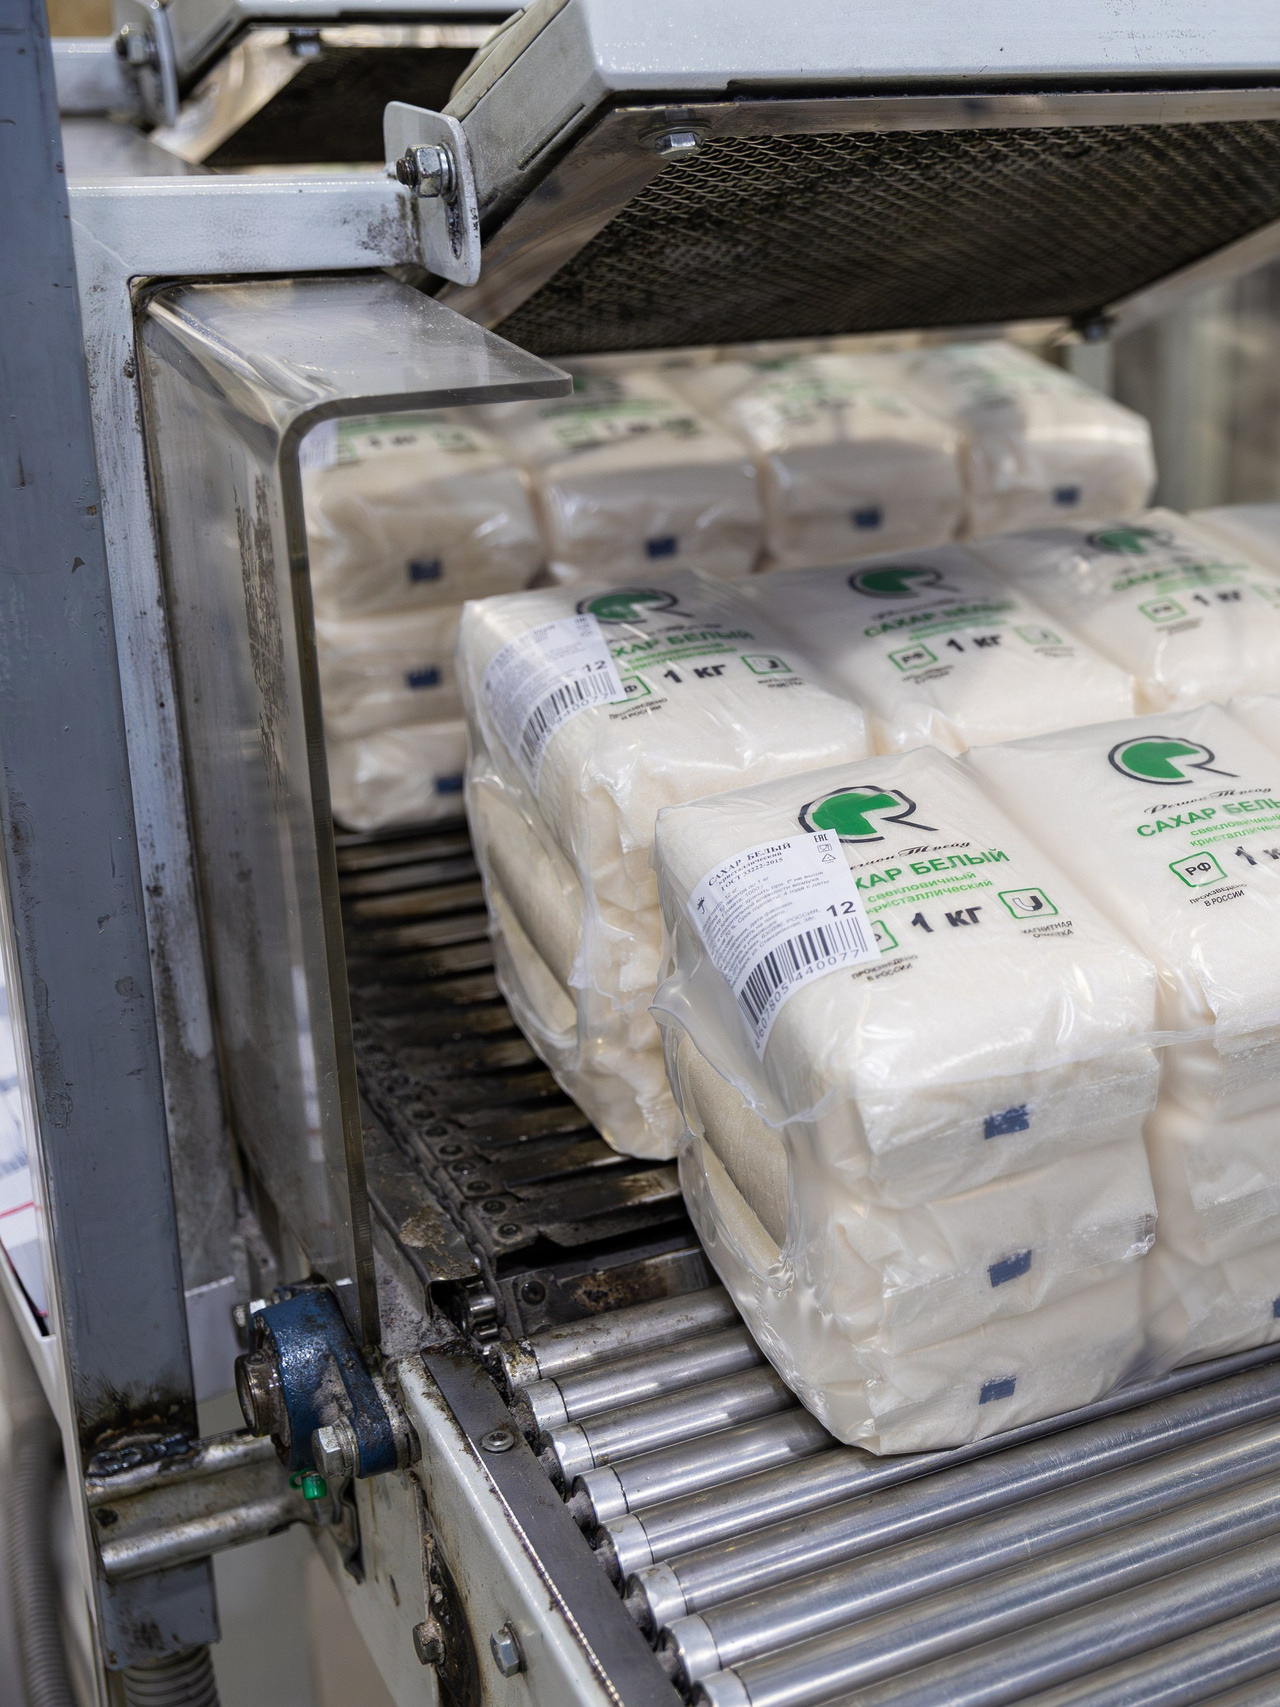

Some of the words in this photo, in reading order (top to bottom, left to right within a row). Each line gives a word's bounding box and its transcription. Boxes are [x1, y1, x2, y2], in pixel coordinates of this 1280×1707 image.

[612, 640, 660, 659] ХАР
[946, 638, 965, 652] 1
[584, 660, 607, 672] 12
[663, 669, 683, 684] 1
[1136, 807, 1217, 838] САХАР
[708, 859, 742, 887] САХАР
[746, 842, 791, 861] БЕЛЫЙ
[849, 854, 895, 871] егион
[1234, 845, 1258, 866] 1
[718, 852, 782, 885] кристаллический
[721, 874, 741, 892] ГОСТ
[743, 858, 784, 877] 33222-2015
[855, 868, 903, 890] ХАР
[908, 848, 1011, 876] БЕЛЫЙ
[1185, 861, 1212, 876] РФ
[866, 879, 994, 915] кристаллический
[867, 871, 977, 904] свекловичный
[1203, 899, 1212, 907] В
[1211, 889, 1245, 906] РОССИИ
[825, 900, 857, 918] 12
[910, 911, 935, 933] 1
[944, 906, 983, 928] кг
[759, 982, 790, 1037] 607805
[794, 949, 860, 982] 440077
